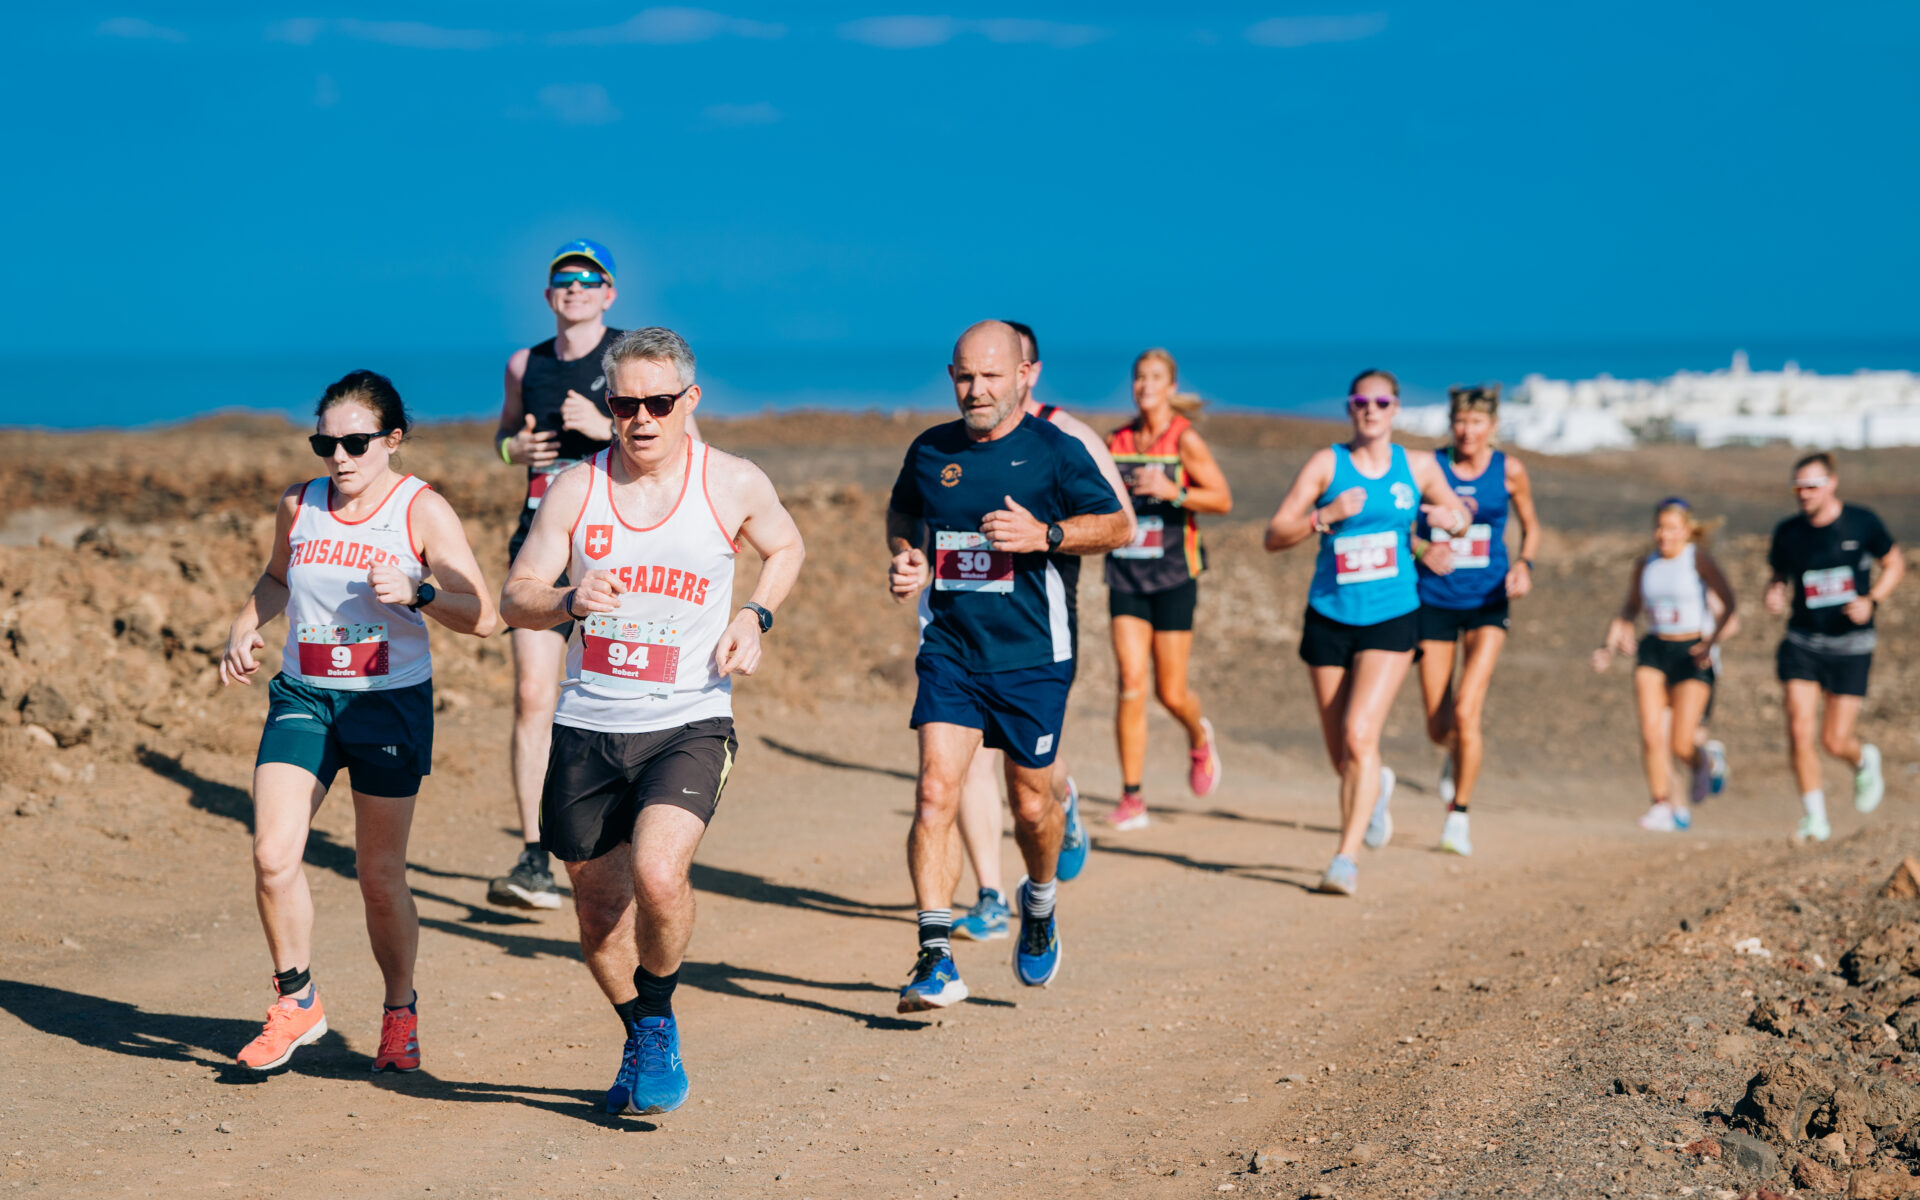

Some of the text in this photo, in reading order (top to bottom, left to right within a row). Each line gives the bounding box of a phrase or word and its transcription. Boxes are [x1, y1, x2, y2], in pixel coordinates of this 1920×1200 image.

[289, 539, 400, 571] RUSADER
[957, 551, 991, 572] 30
[609, 565, 710, 606] SADERS
[331, 646, 352, 669] 9
[608, 642, 650, 670] 94
[612, 667, 640, 678] Robert
